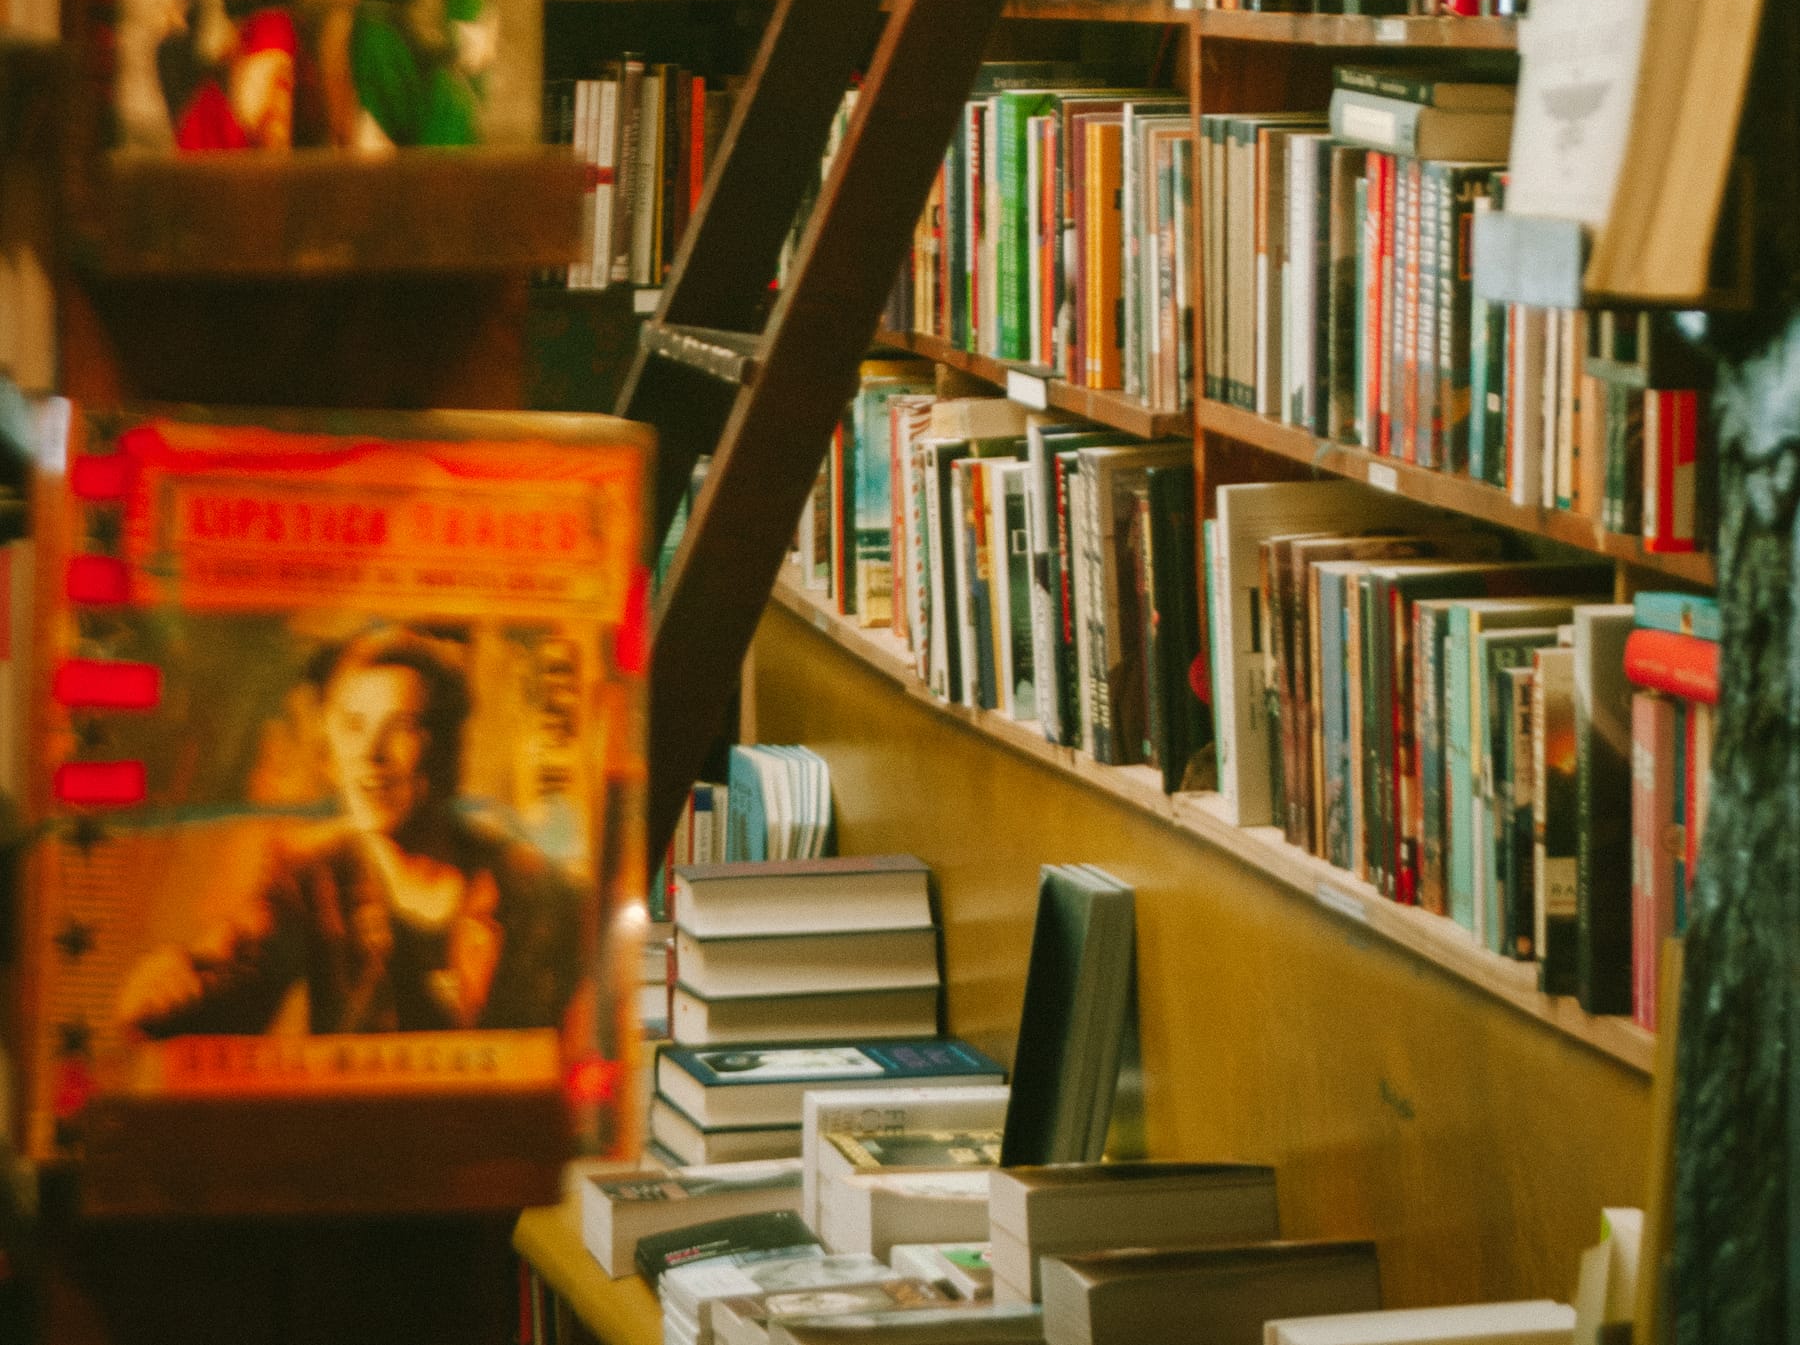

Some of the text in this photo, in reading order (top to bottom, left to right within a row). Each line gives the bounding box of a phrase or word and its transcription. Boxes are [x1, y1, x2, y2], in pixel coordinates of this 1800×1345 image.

[1405, 177, 1419, 265] JASPER
[1419, 176, 1436, 266] JASPER
[1440, 179, 1452, 270] JASPER
